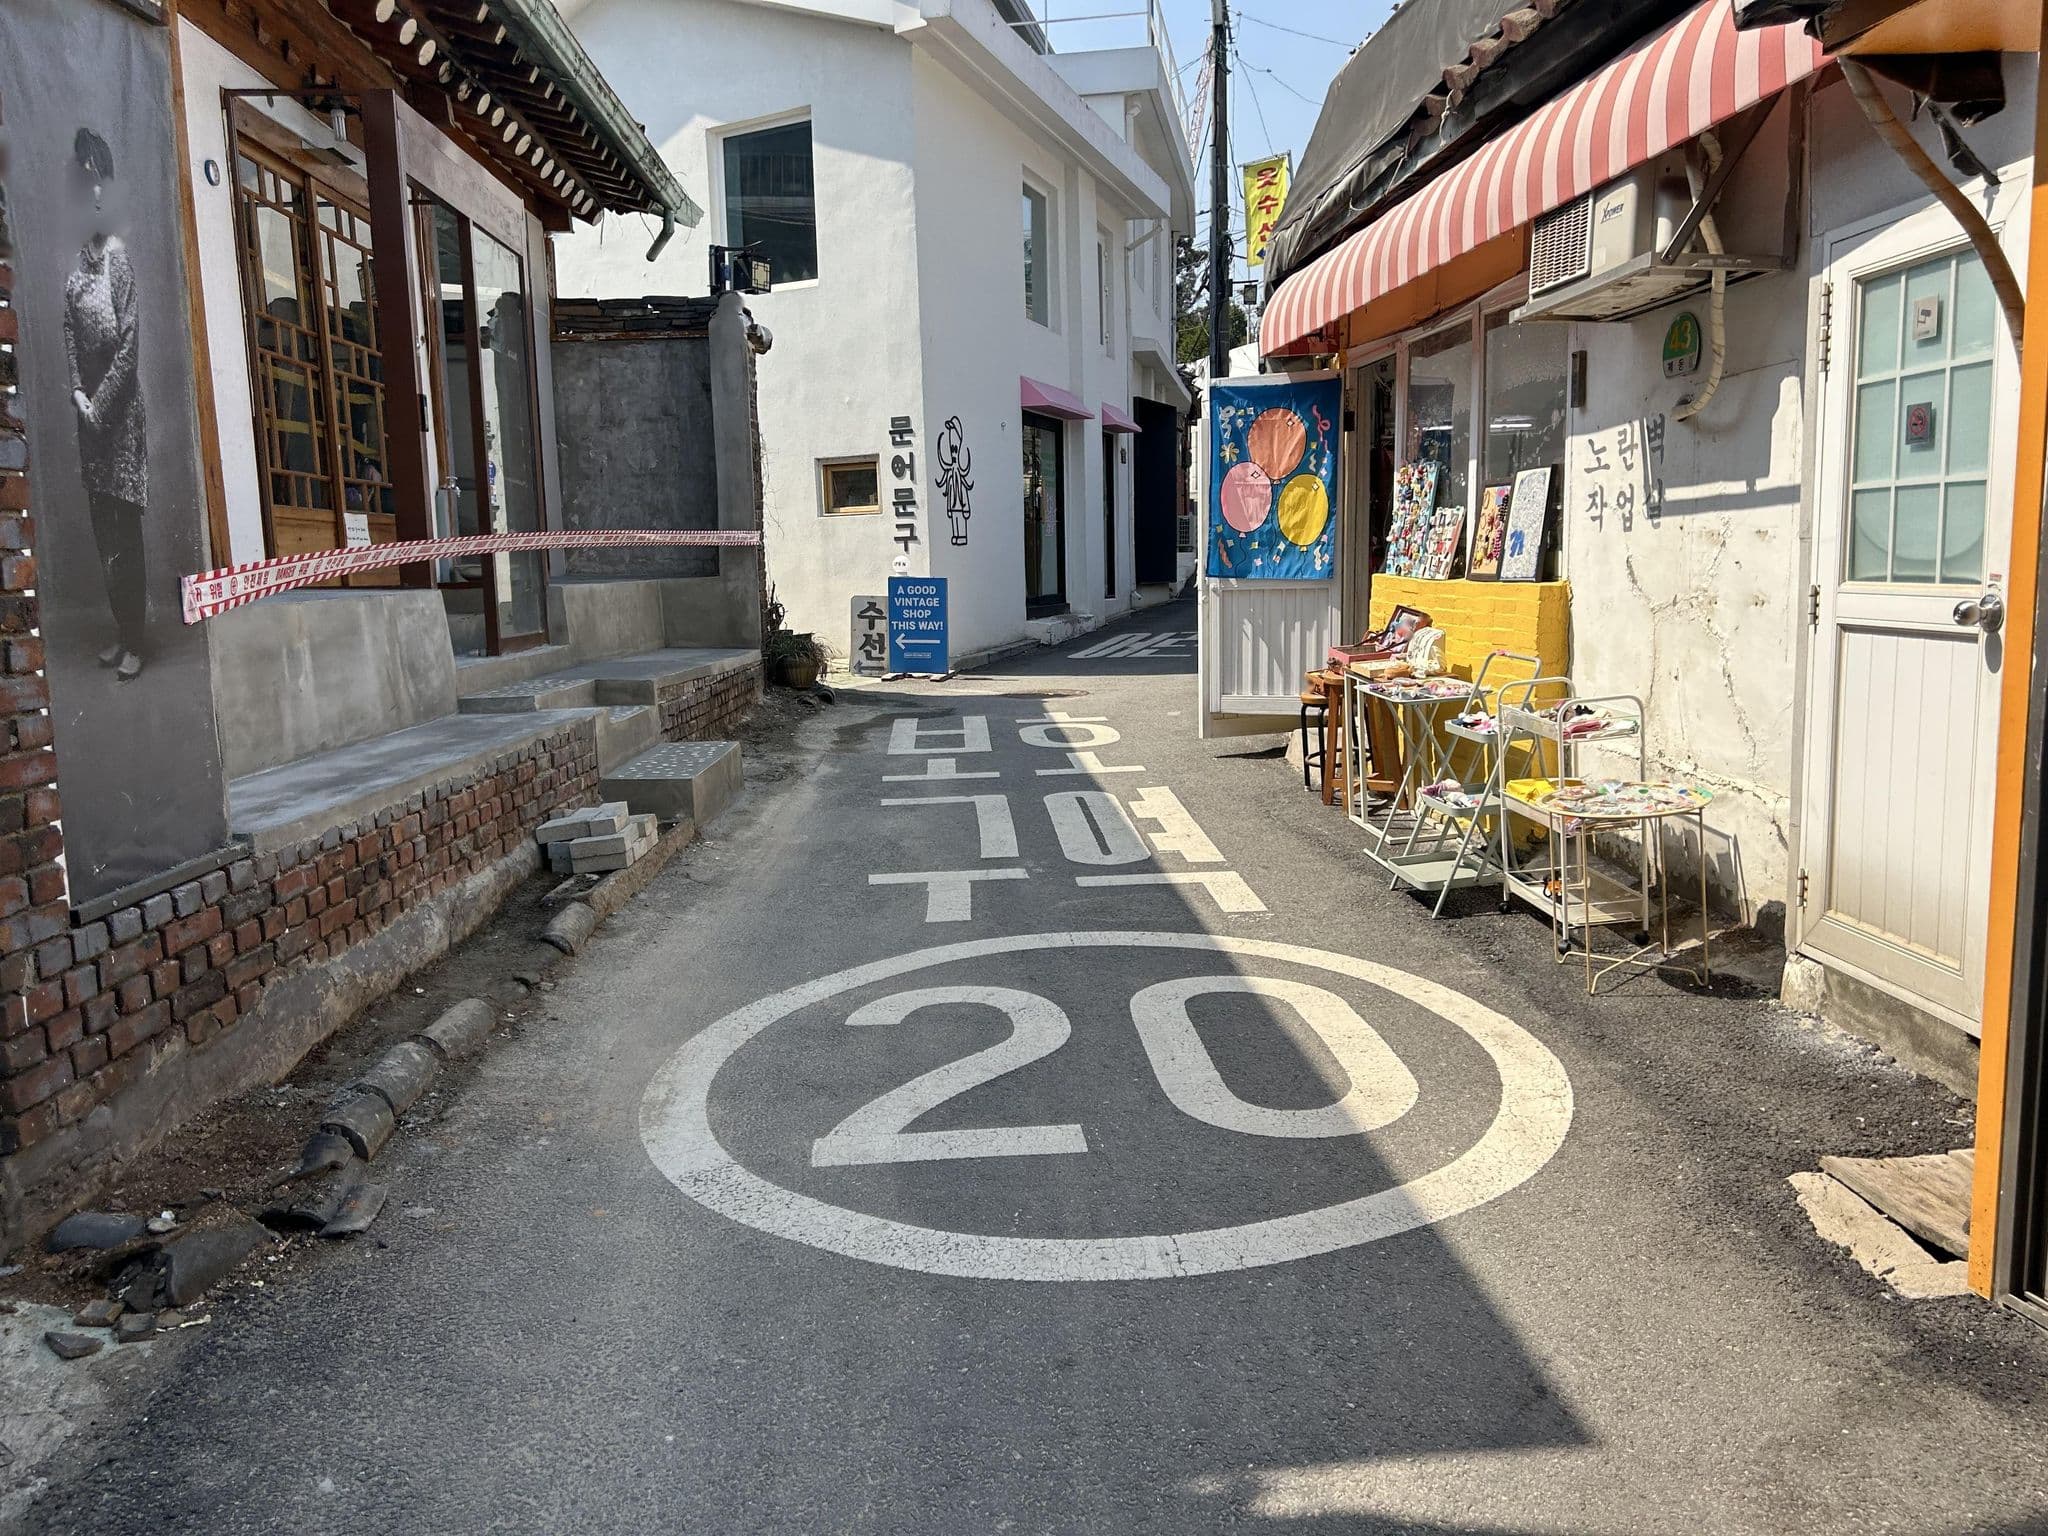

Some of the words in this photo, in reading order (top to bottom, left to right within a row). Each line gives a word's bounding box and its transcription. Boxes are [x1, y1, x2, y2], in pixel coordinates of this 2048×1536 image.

[889, 415, 918, 552] 문어문구
[897, 586, 905, 595] A
[907, 586, 936, 595] GOOD
[894, 597, 940, 607] VINTAGE
[903, 609, 932, 619] SHOP
[891, 621, 916, 630] THIS
[918, 621, 944, 631] WAY!
[857, 602, 887, 661] 수선
[811, 975, 1420, 1168] 20
